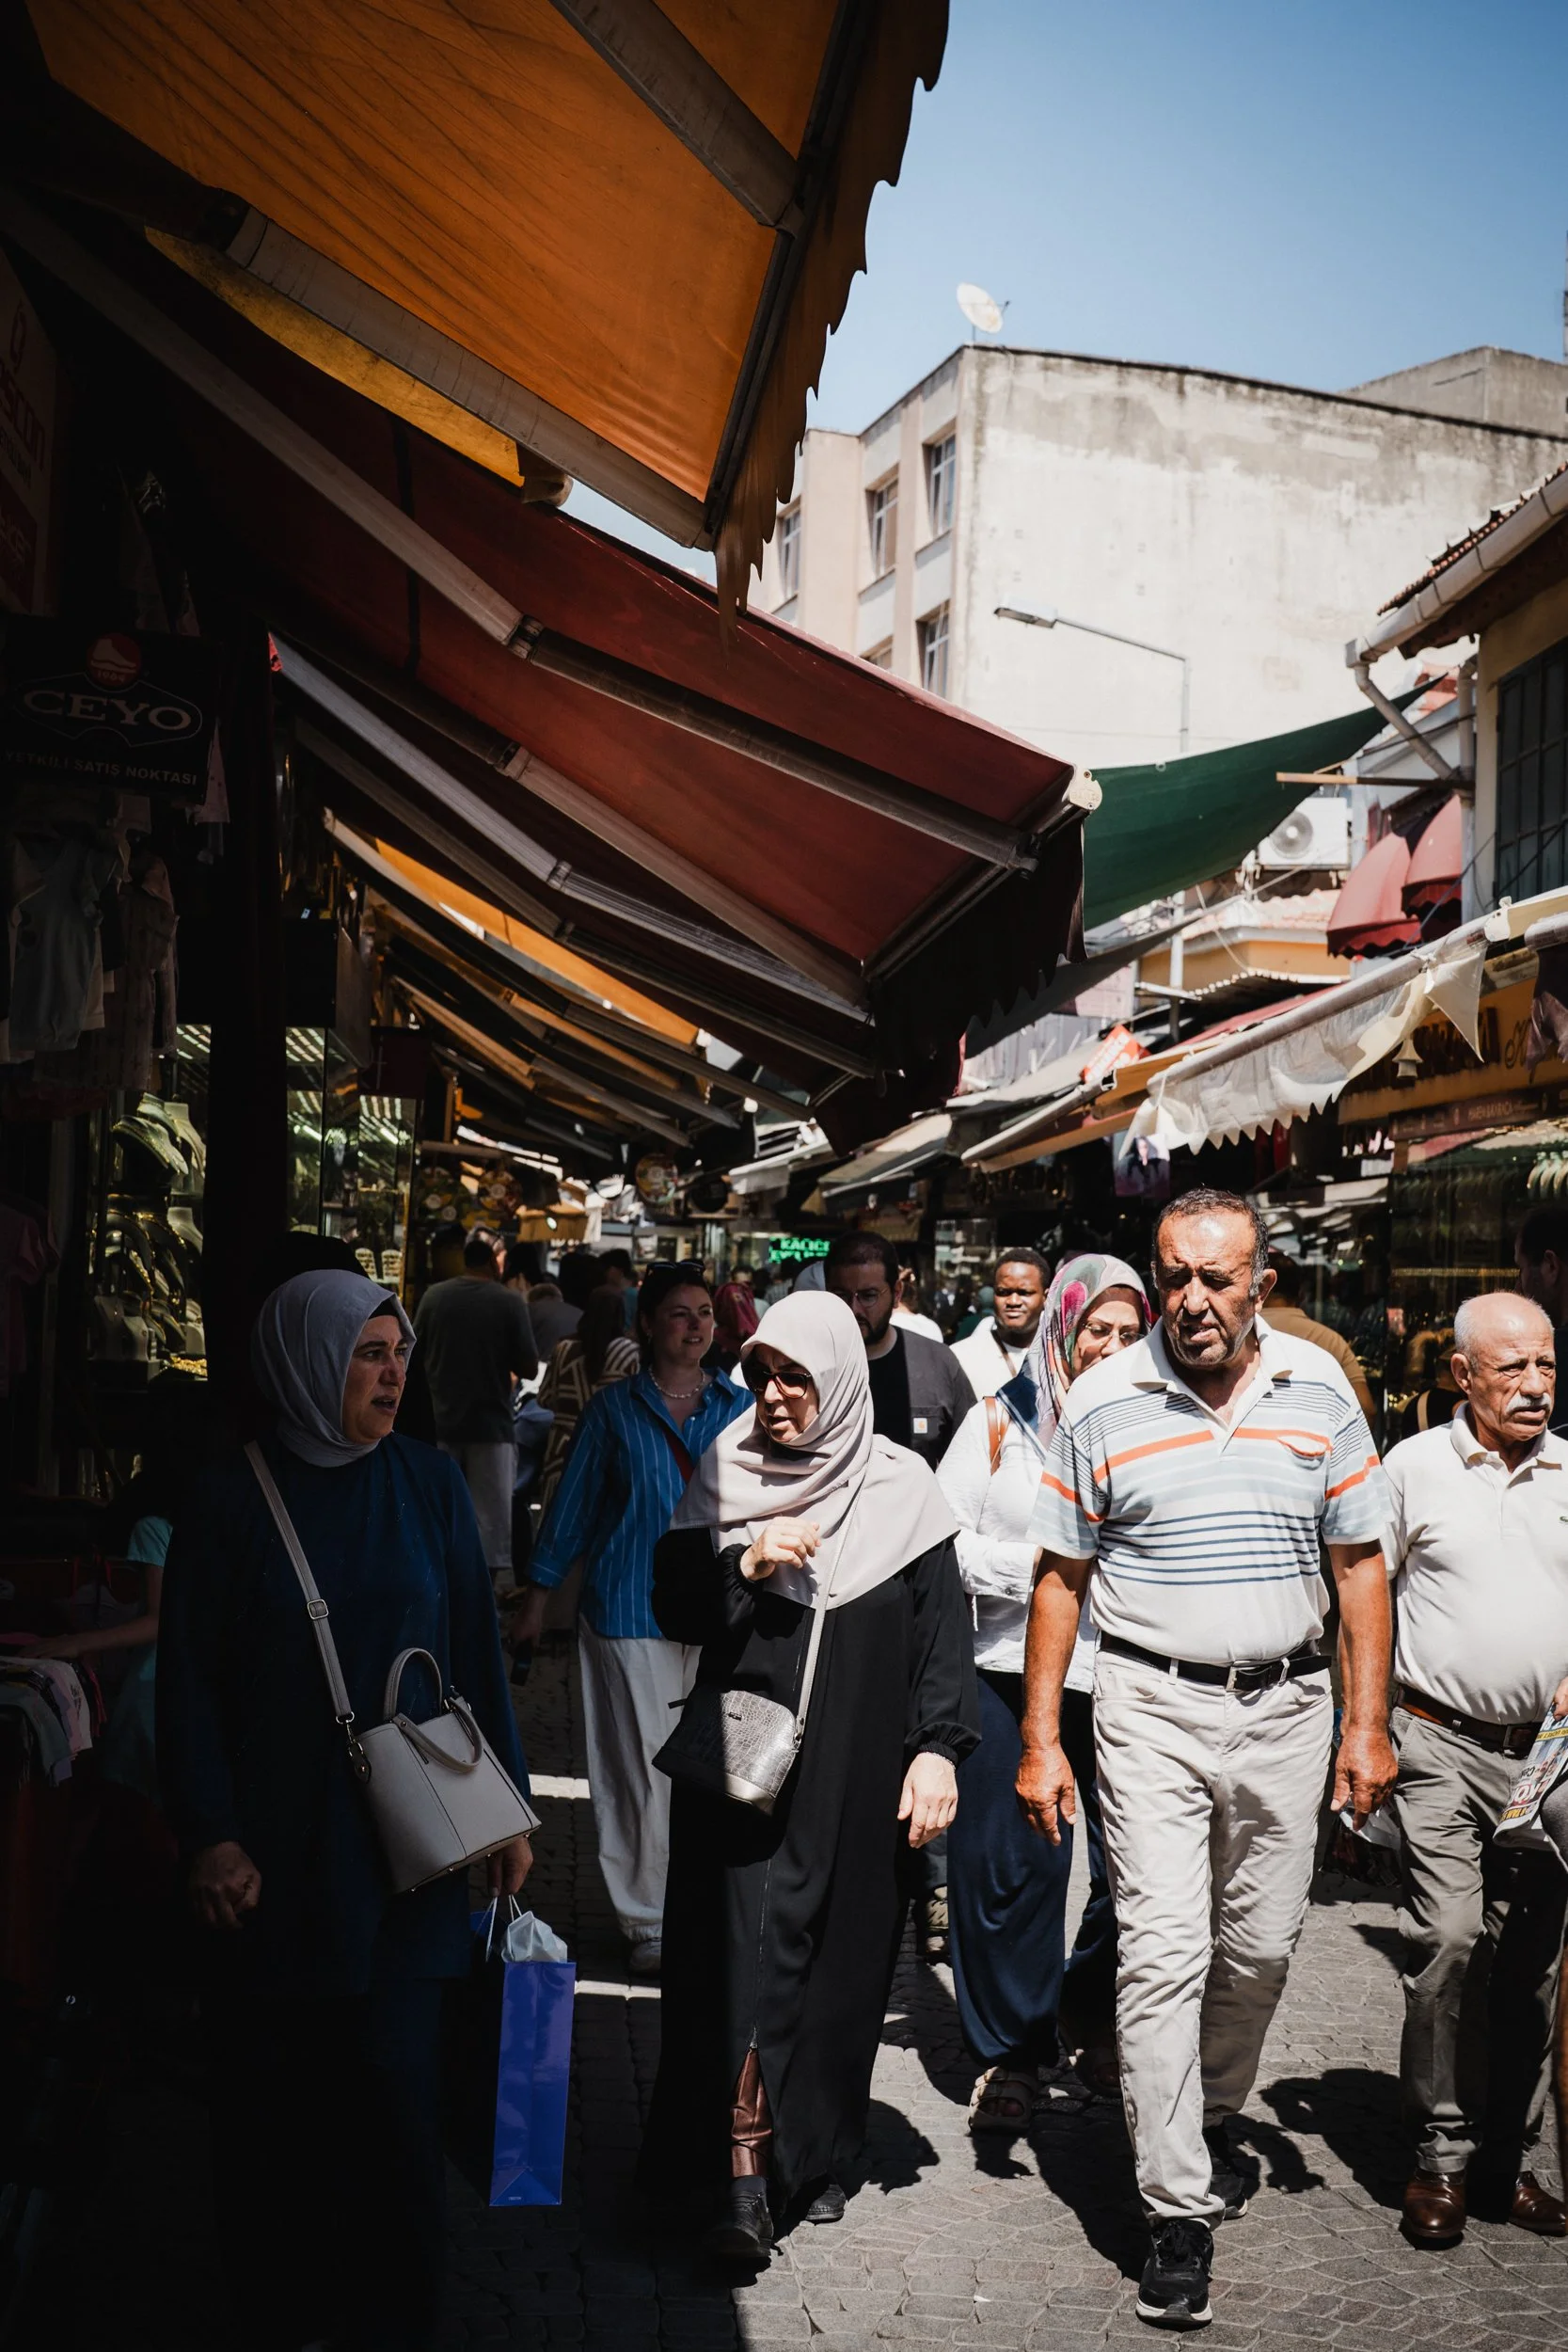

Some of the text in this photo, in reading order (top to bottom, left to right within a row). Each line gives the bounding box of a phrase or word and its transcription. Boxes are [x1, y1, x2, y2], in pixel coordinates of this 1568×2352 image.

[24, 690, 192, 731] CEYO
[73, 759, 121, 779] SATIŞ
[125, 765, 198, 787] NOKTASI
